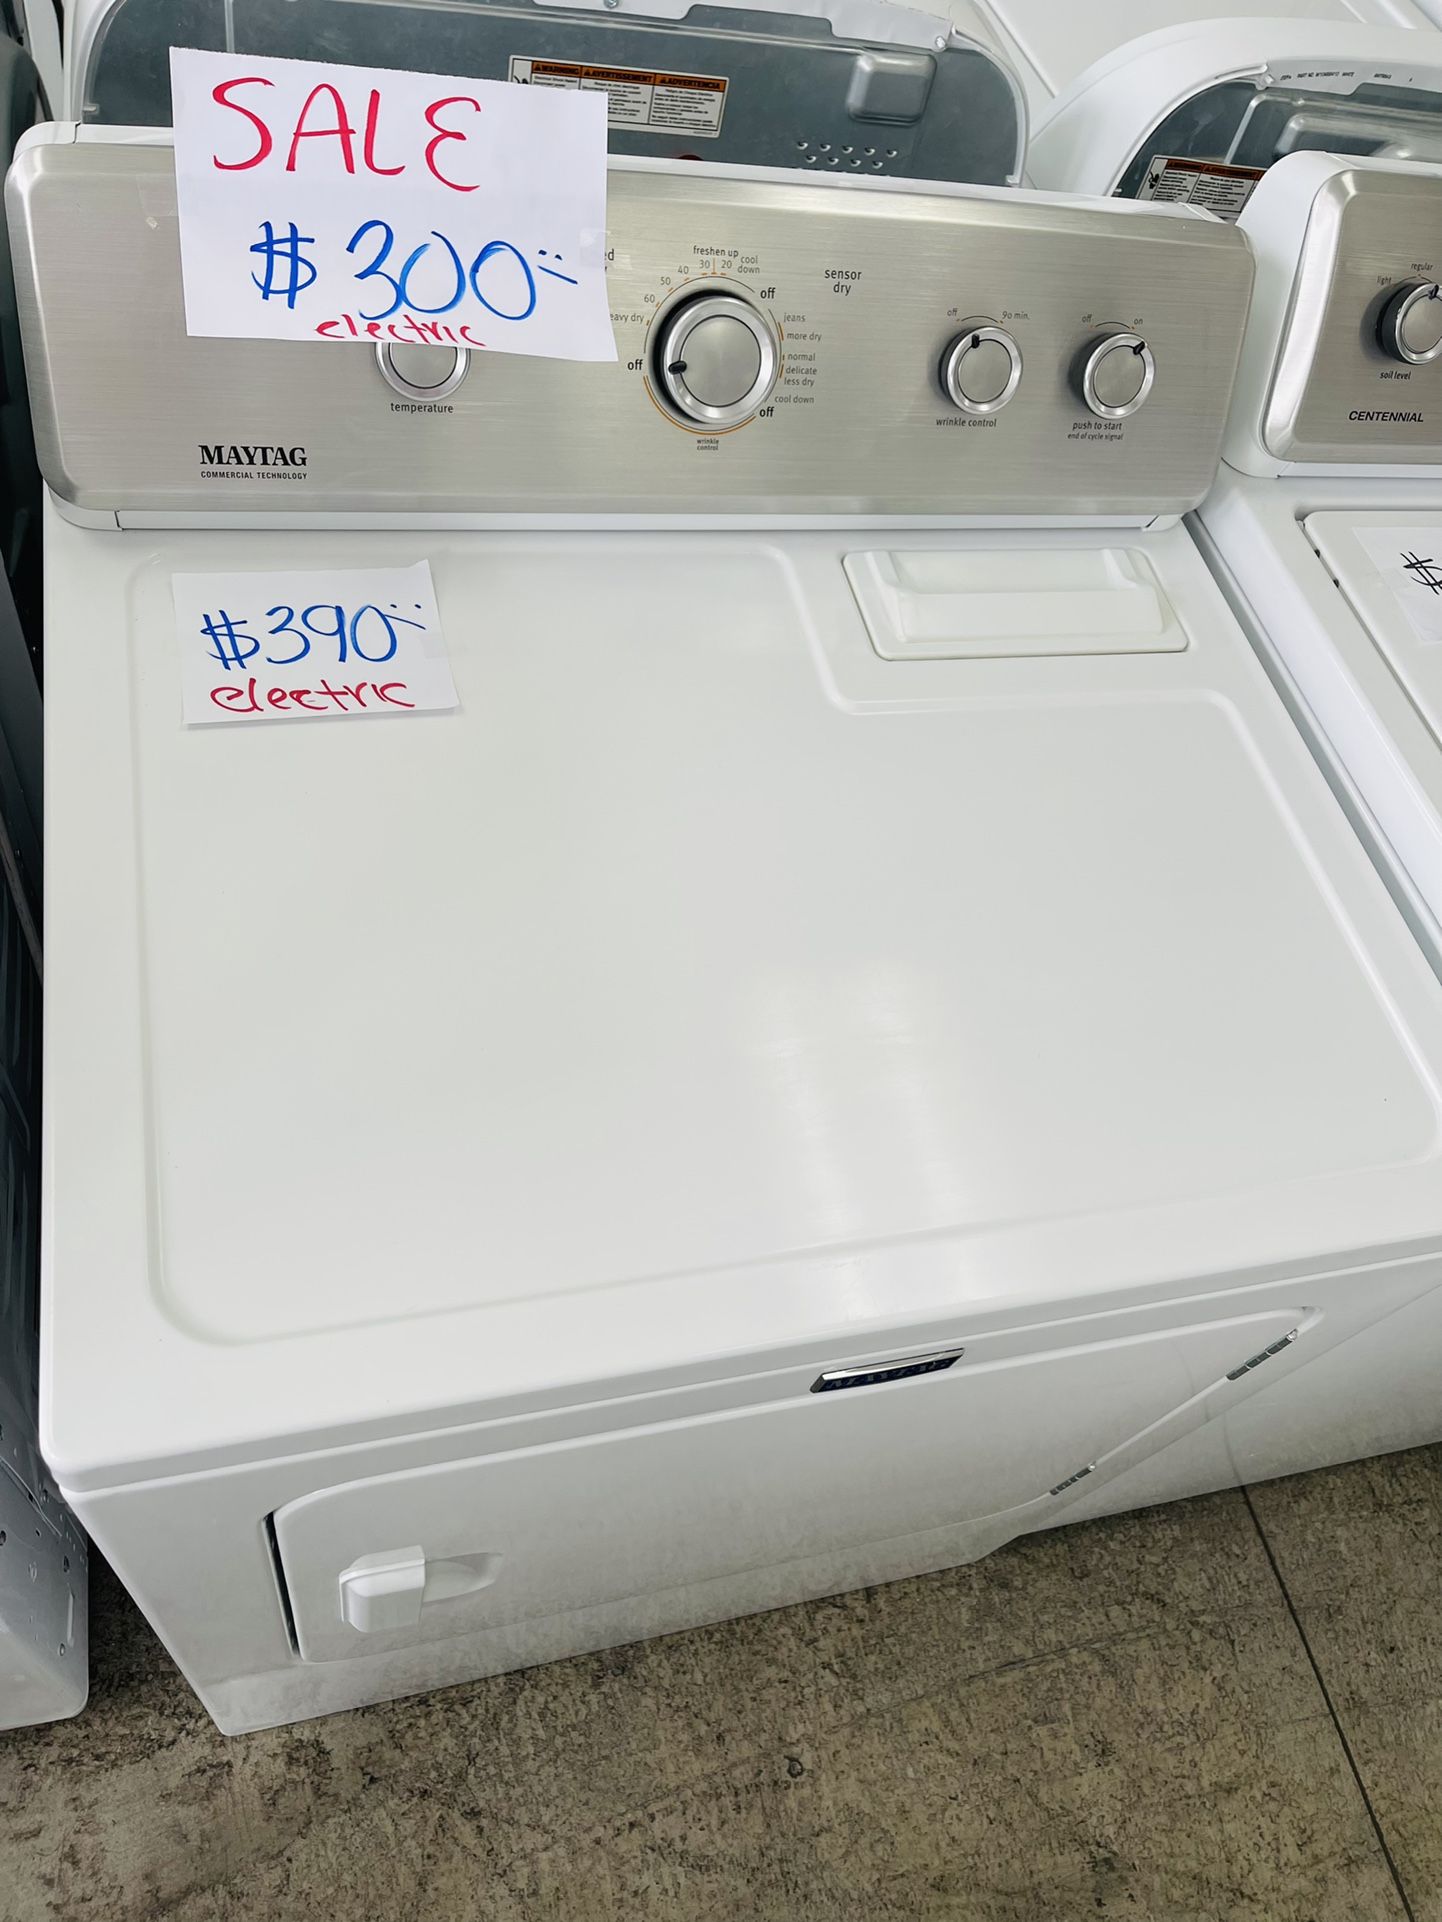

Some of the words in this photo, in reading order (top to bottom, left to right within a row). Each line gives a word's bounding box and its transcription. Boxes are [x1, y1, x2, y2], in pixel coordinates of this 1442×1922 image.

[212, 76, 483, 193] SALE
[693, 245, 726, 256] freshen
[728, 249, 739, 258] up
[699, 259, 711, 269] 30
[721, 259, 733, 269] 20
[740, 255, 759, 264] cool
[677, 265, 690, 275] 40
[737, 265, 760, 274] down
[1410, 261, 1434, 272] regular
[824, 268, 863, 281] sensor
[660, 276, 672, 286] 50
[1377, 275, 1392, 286] light
[760, 287, 777, 299] off
[833, 281, 852, 297] dry
[643, 294, 656, 304] 60
[609, 312, 630, 323] eavy
[630, 312, 645, 323] dry
[783, 312, 806, 323] jeans
[947, 308, 958, 317] off
[1081, 314, 1092, 324] off
[1134, 317, 1144, 325] on
[314, 313, 487, 347] electric
[786, 332, 807, 341] more
[809, 331, 823, 342] dry
[787, 352, 816, 362] normal
[627, 359, 644, 371] off
[785, 365, 818, 375] delicate
[1379, 369, 1394, 380] soil
[1394, 370, 1412, 381] level
[784, 377, 800, 386] less
[802, 377, 816, 388] dry
[774, 394, 792, 403] cool
[793, 394, 815, 404] down
[390, 402, 454, 414] temperature
[759, 406, 775, 418] off
[1349, 410, 1425, 423] CENTENNIAL
[936, 417, 967, 427] wrinkle
[968, 417, 997, 428] control
[1072, 420, 1092, 431] push
[1094, 422, 1102, 430] to
[1103, 422, 1122, 431] start
[1087, 433, 1104, 441] cycle
[1104, 433, 1124, 441] signal
[198, 444, 308, 467] MAYTAG
[200, 471, 254, 479] COMMERCIAL
[257, 472, 308, 480] TECHNOLOGY
[210, 677, 416, 713] electric
